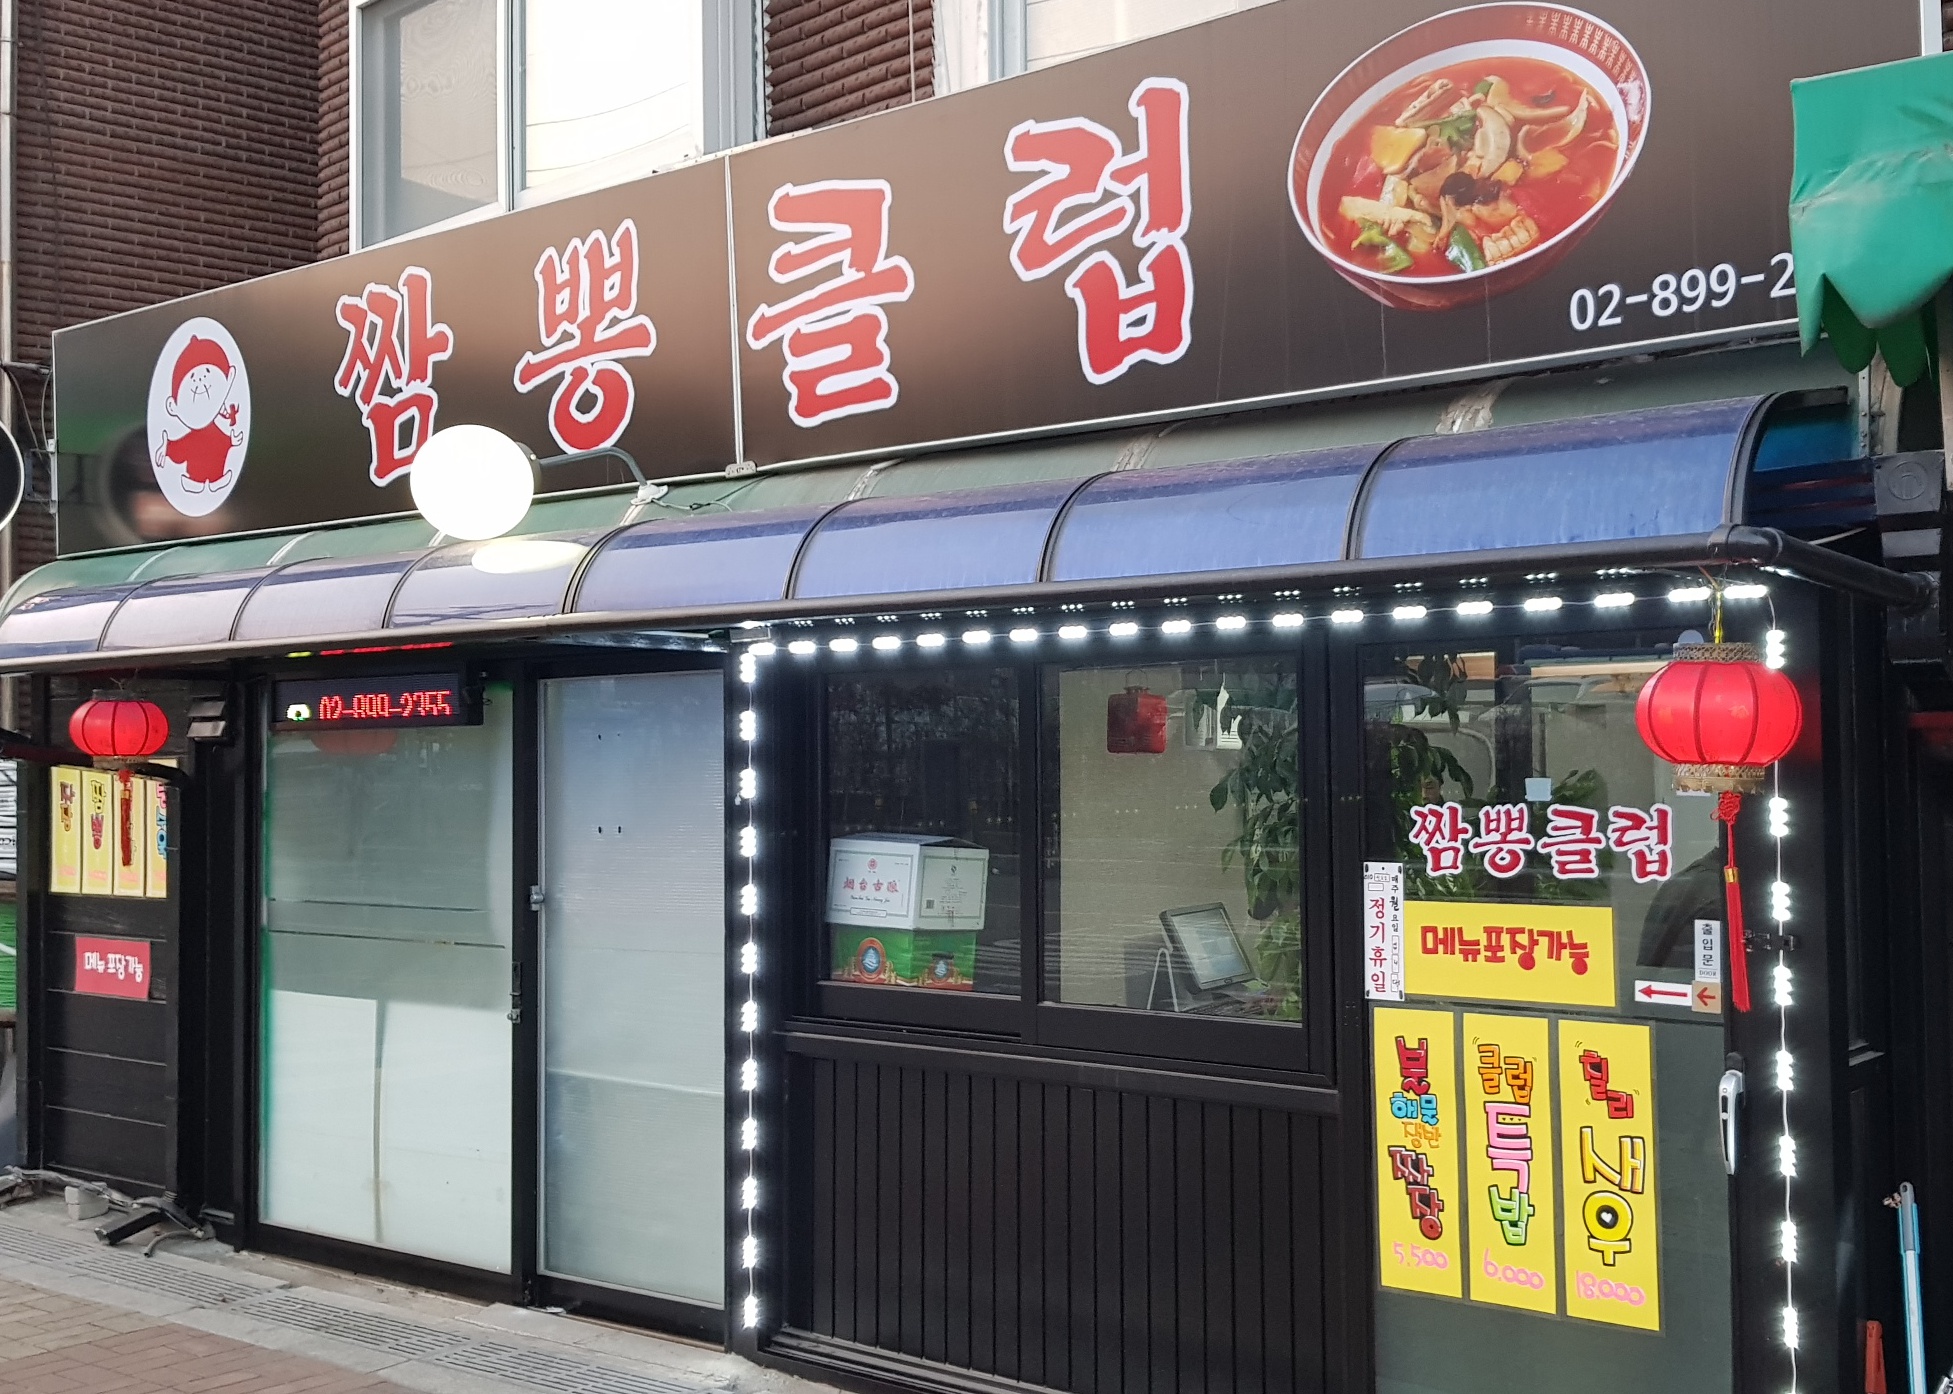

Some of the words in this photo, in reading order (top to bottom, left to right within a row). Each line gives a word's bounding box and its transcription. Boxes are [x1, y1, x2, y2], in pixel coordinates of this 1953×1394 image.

[1569, 252, 1797, 331] 02-899-2
[1409, 801, 1673, 883] 짬뽕클럽
[1368, 896, 1387, 993] 정기휴일
[1701, 923, 1713, 966] 출입문
[1580, 1126, 1646, 1267] 새우
